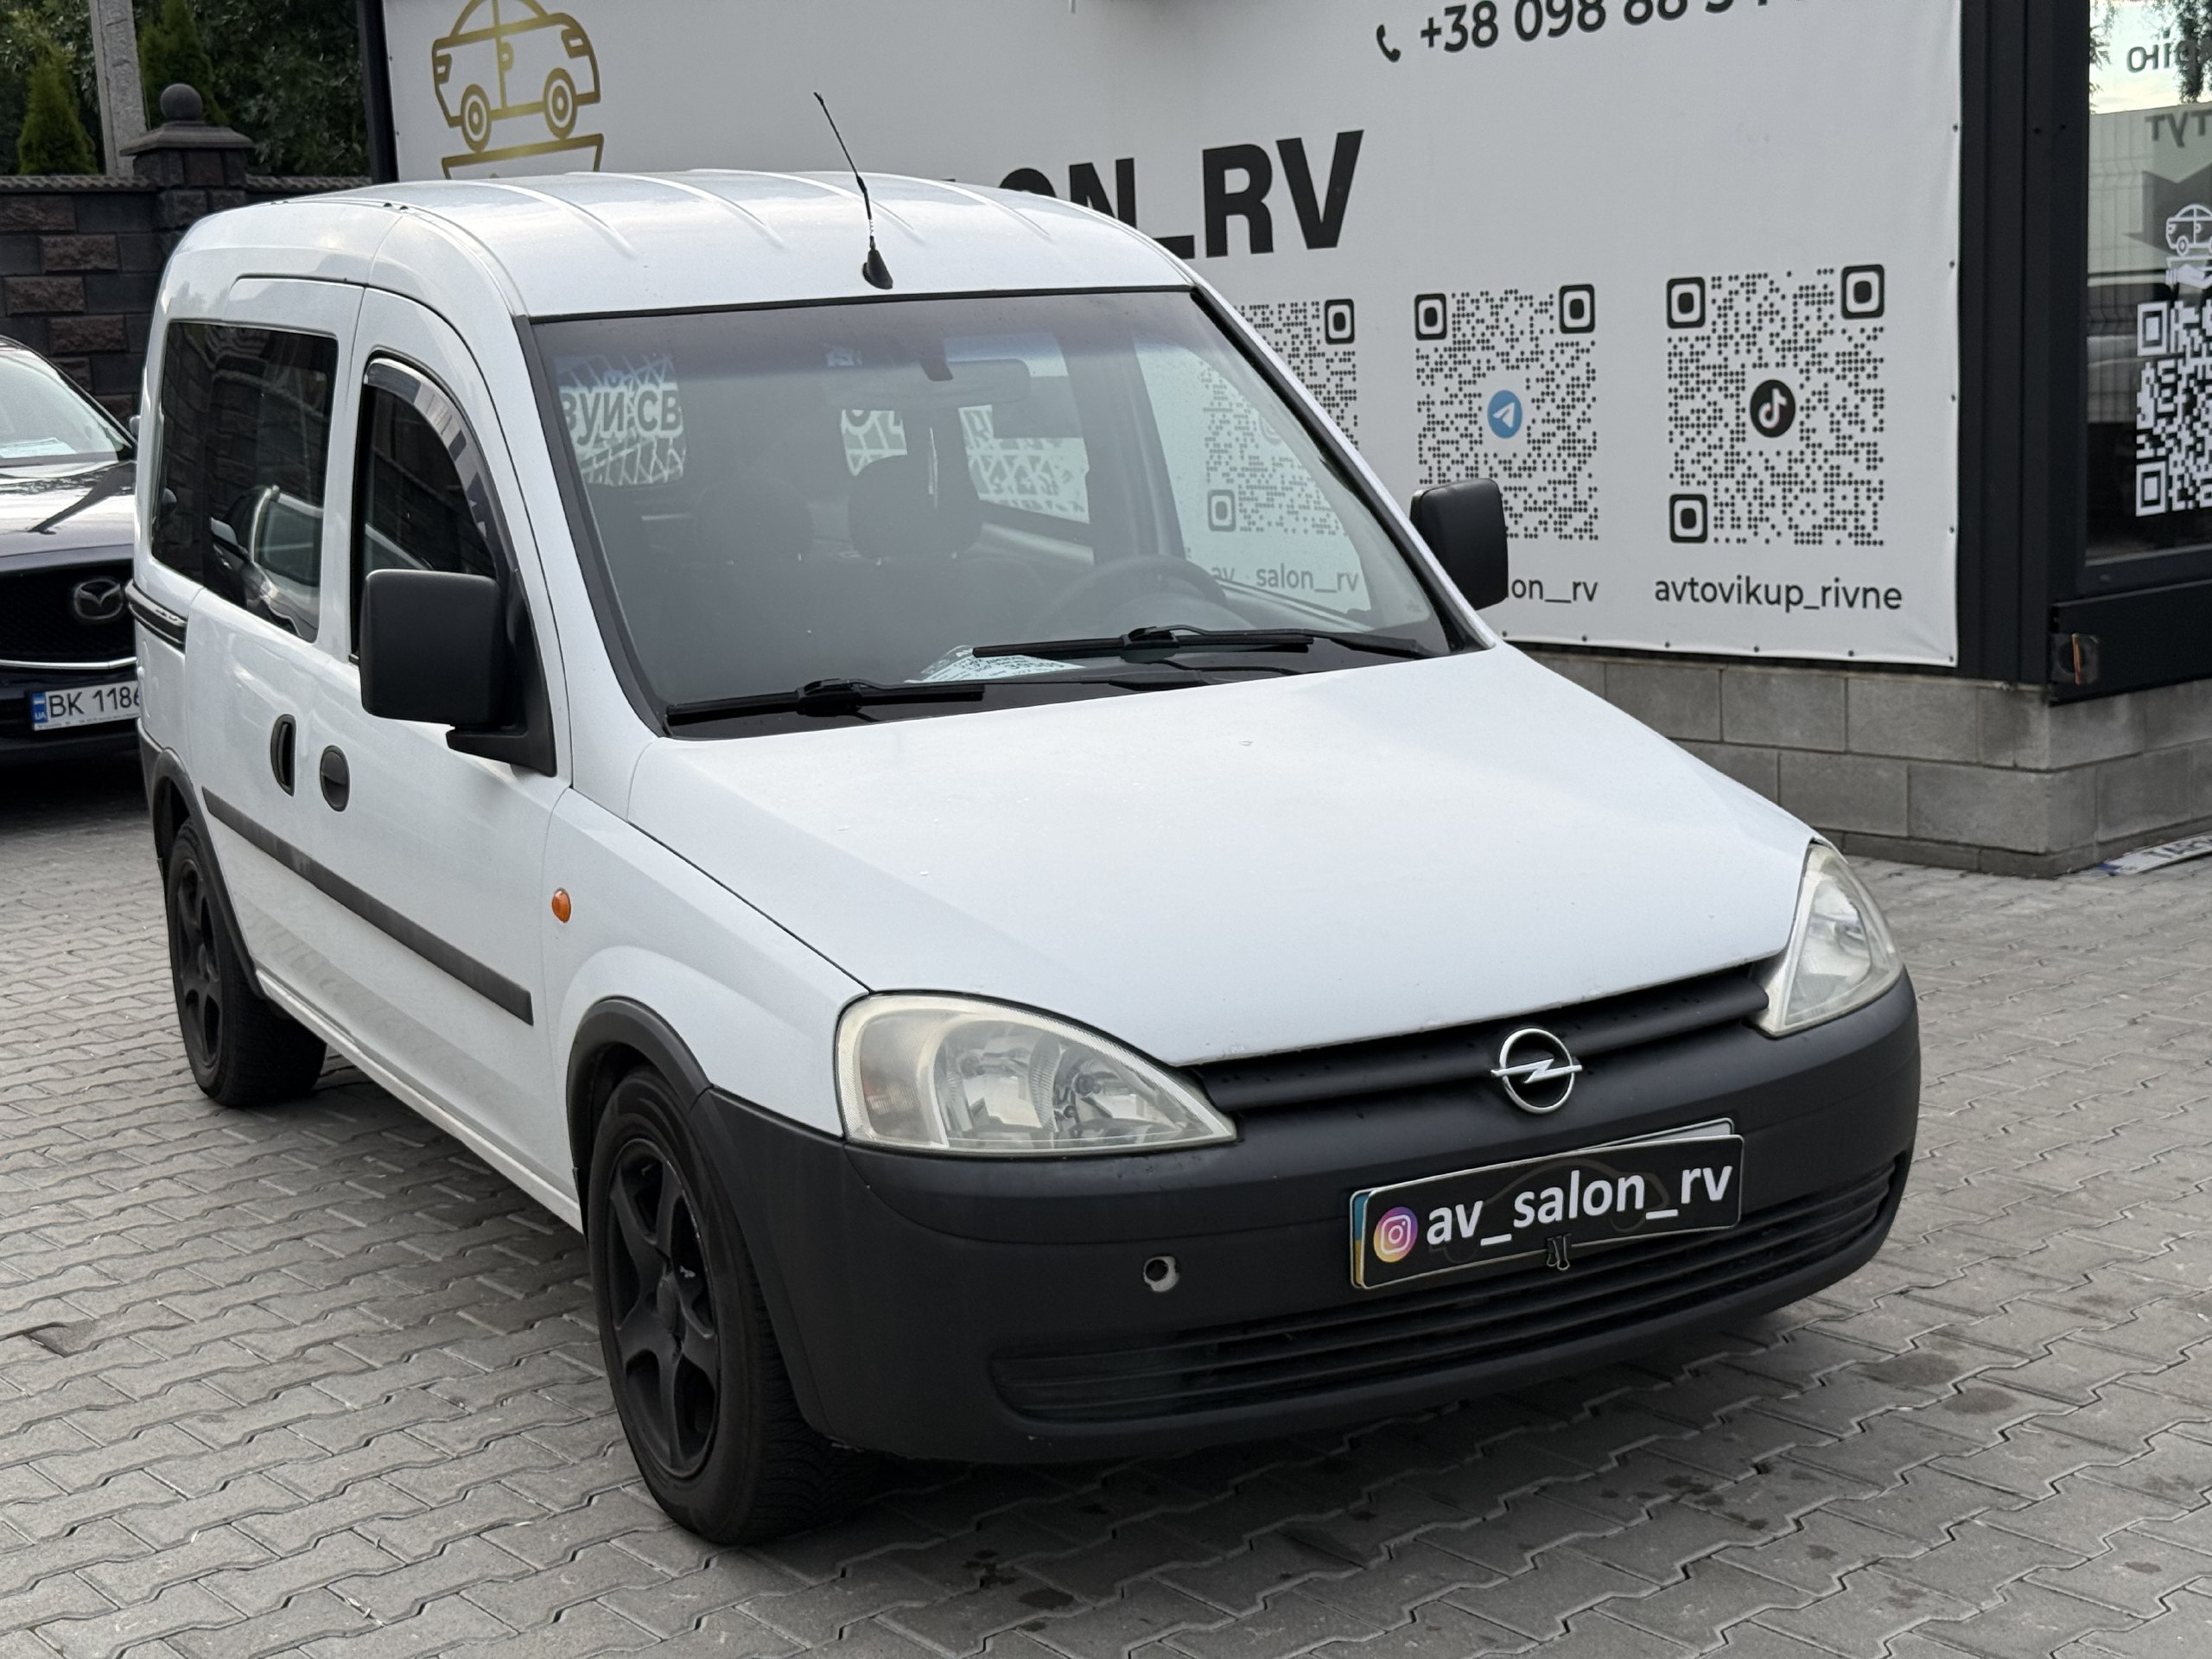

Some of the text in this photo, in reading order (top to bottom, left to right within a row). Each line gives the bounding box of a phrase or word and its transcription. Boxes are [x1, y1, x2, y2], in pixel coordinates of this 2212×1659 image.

[1421, 3, 1500, 54] +38
[1514, 0, 1606, 41] 098
[1507, 577, 1599, 604] on_rv
[1654, 574, 1903, 613] avtovikup_rivne
[35, 711, 47, 721] UA
[48, 691, 85, 718] BK
[1426, 1165, 1733, 1247] av_salon_rv
